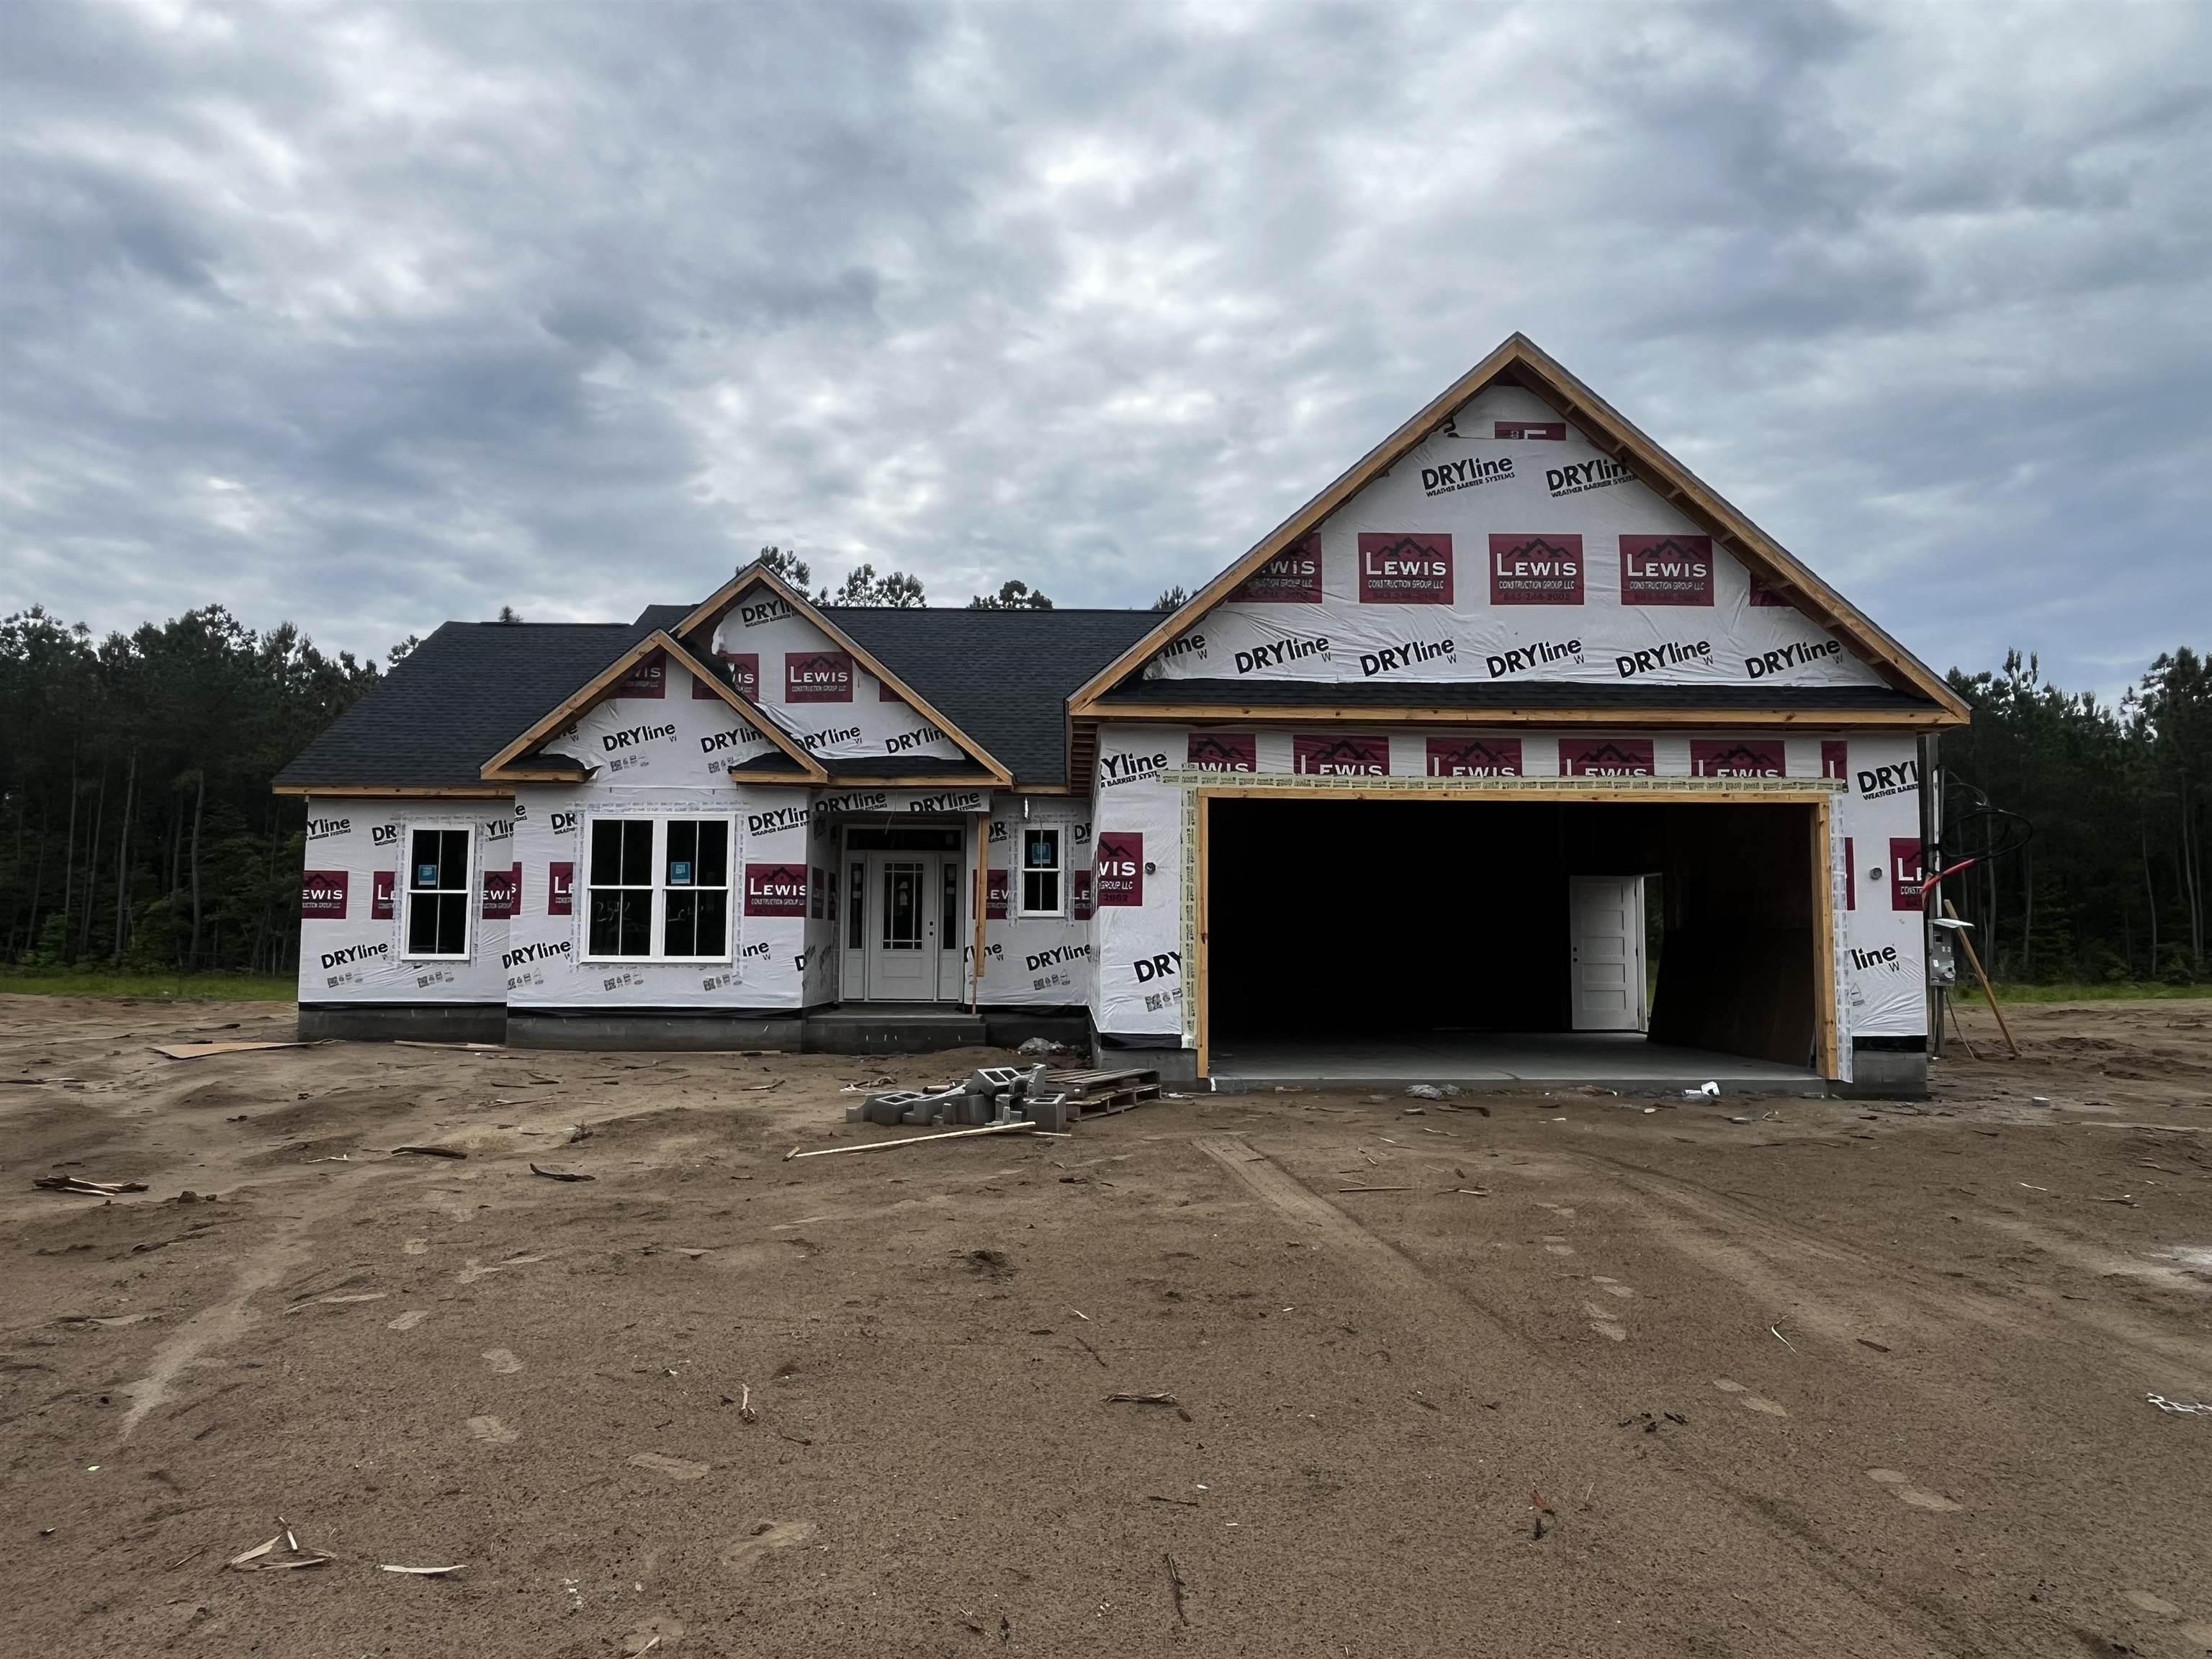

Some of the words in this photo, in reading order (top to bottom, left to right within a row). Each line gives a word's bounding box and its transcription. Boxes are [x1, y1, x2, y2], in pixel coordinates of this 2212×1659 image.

[1421, 457, 1513, 490] DRYline
[1546, 459, 1628, 491] DRYlin
[1270, 561, 1316, 575] WIS
[1366, 552, 1447, 575] LEWIS
[1497, 552, 1577, 576] LEWIS
[1627, 553, 1707, 577] LEWIS
[1498, 580, 1542, 589] CONSTRUCTION
[1542, 580, 1563, 589] GROUP
[1563, 580, 1575, 589] LLC
[1234, 637, 1330, 674] DRYline
[1359, 639, 1455, 677] DRYline
[1486, 639, 1582, 678] DRYline
[1615, 640, 1711, 678] DRYline
[1745, 639, 1841, 679] DRYline
[790, 666, 848, 683] LEWIS
[603, 724, 675, 752] DRYline
[701, 727, 762, 753] DRYlin
[885, 727, 945, 754] DRYlin
[1100, 752, 1168, 780] Yline
[1857, 760, 1918, 793] DRYl
[748, 807, 808, 832] DRYlin
[1121, 881, 1133, 890] LLC
[321, 943, 388, 969] DRYline
[502, 941, 571, 969] DRYline
[1026, 944, 1091, 971] DRYline
[1851, 946, 1897, 971] line
[1888, 961, 1899, 972] W
